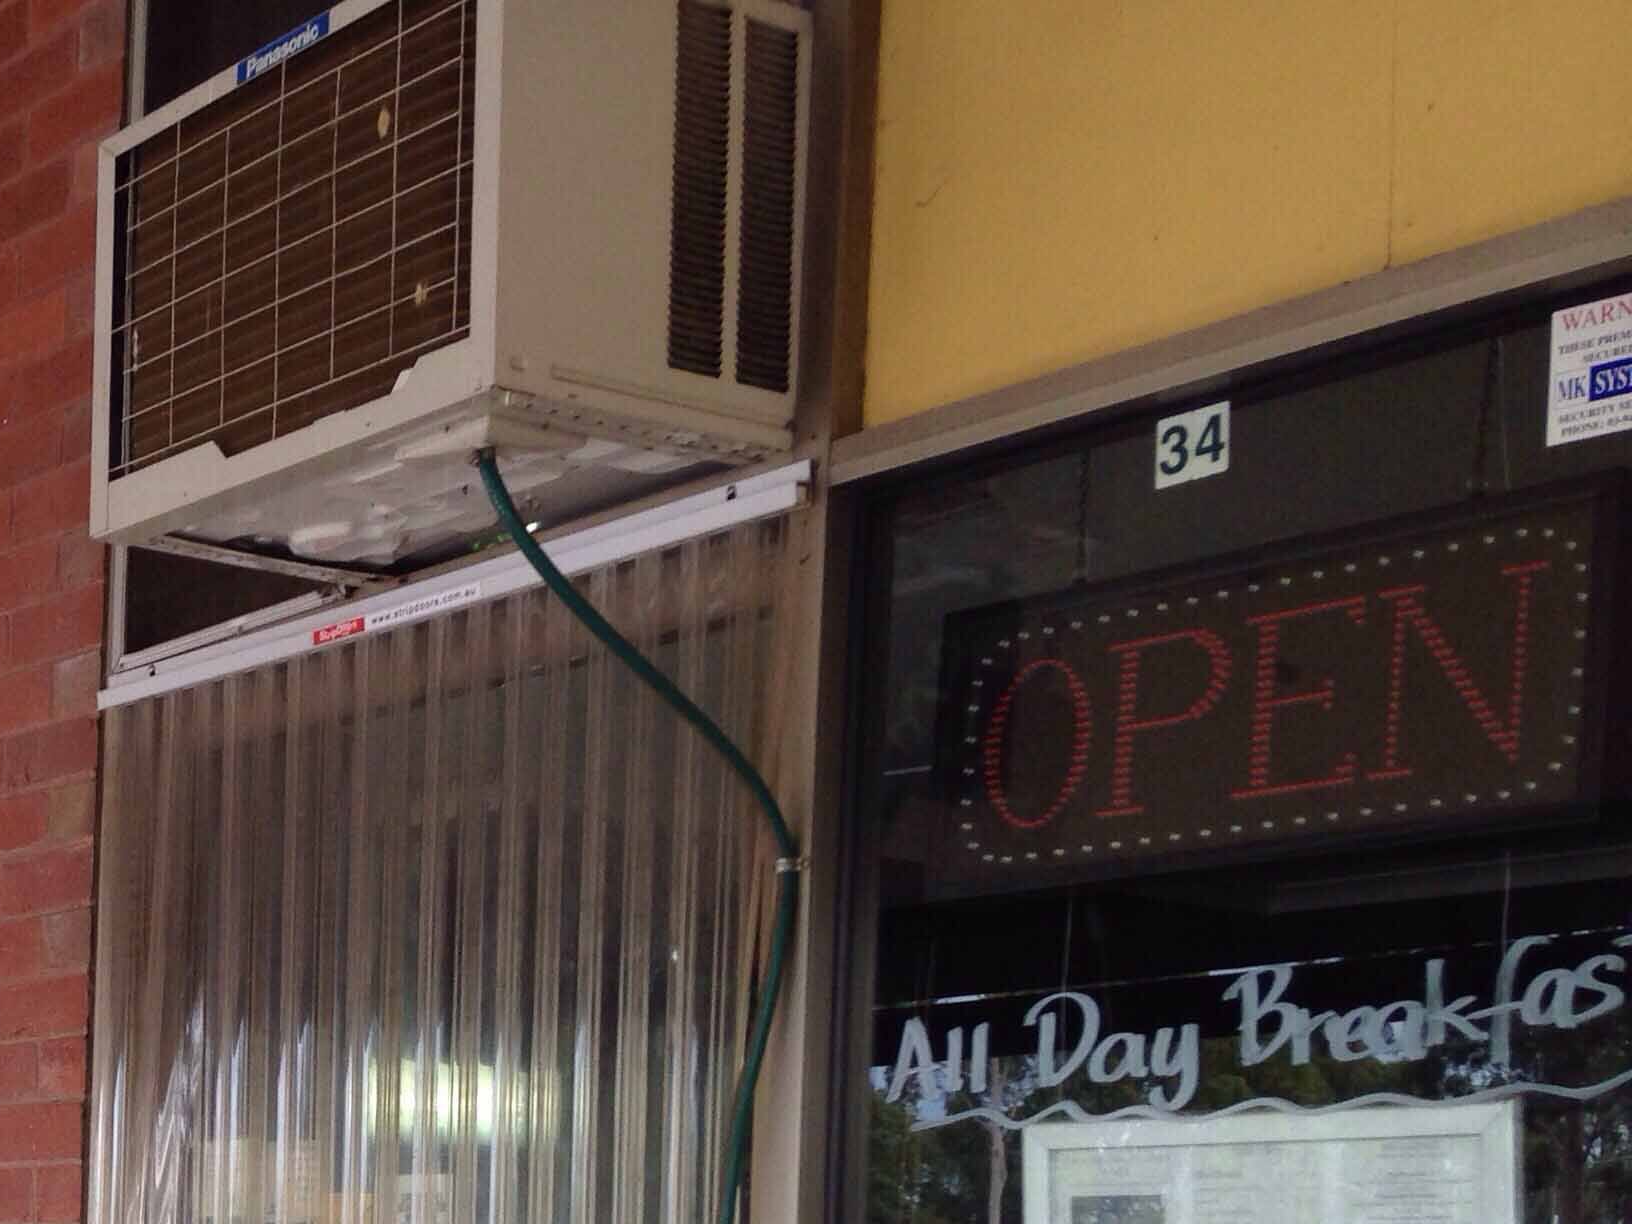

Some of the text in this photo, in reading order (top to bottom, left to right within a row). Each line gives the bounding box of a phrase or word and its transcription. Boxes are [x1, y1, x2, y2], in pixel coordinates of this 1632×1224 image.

[245, 22, 320, 79] Panasonic
[1158, 420, 1228, 477] 34
[982, 559, 1552, 831] OPEN
[883, 934, 1632, 1108] All Day Breakfas
